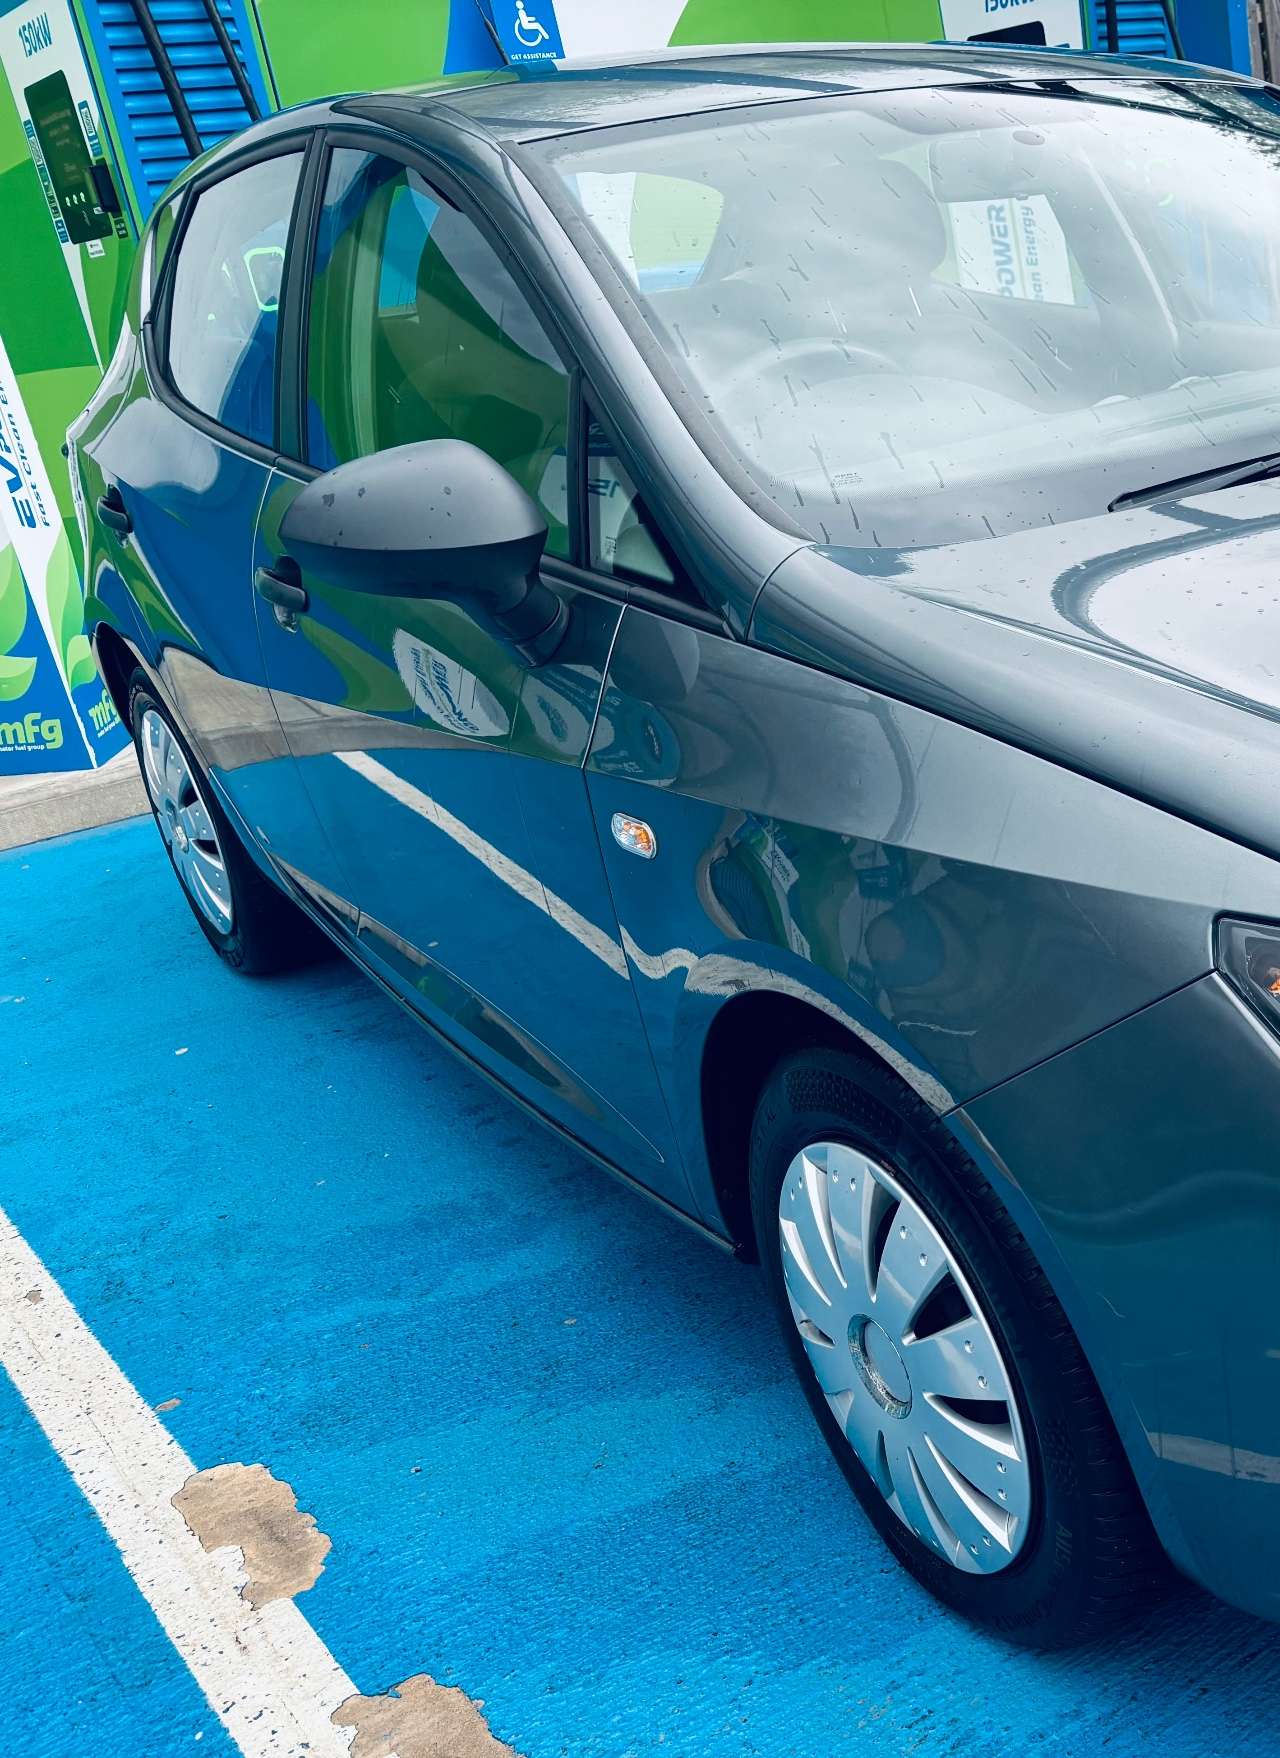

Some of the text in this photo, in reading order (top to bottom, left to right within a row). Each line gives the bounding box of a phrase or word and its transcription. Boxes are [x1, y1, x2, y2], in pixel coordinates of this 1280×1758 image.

[18, 13, 52, 57] 150kW
[7, 413, 51, 527] Fast Clean
[0, 712, 64, 749] mfg
